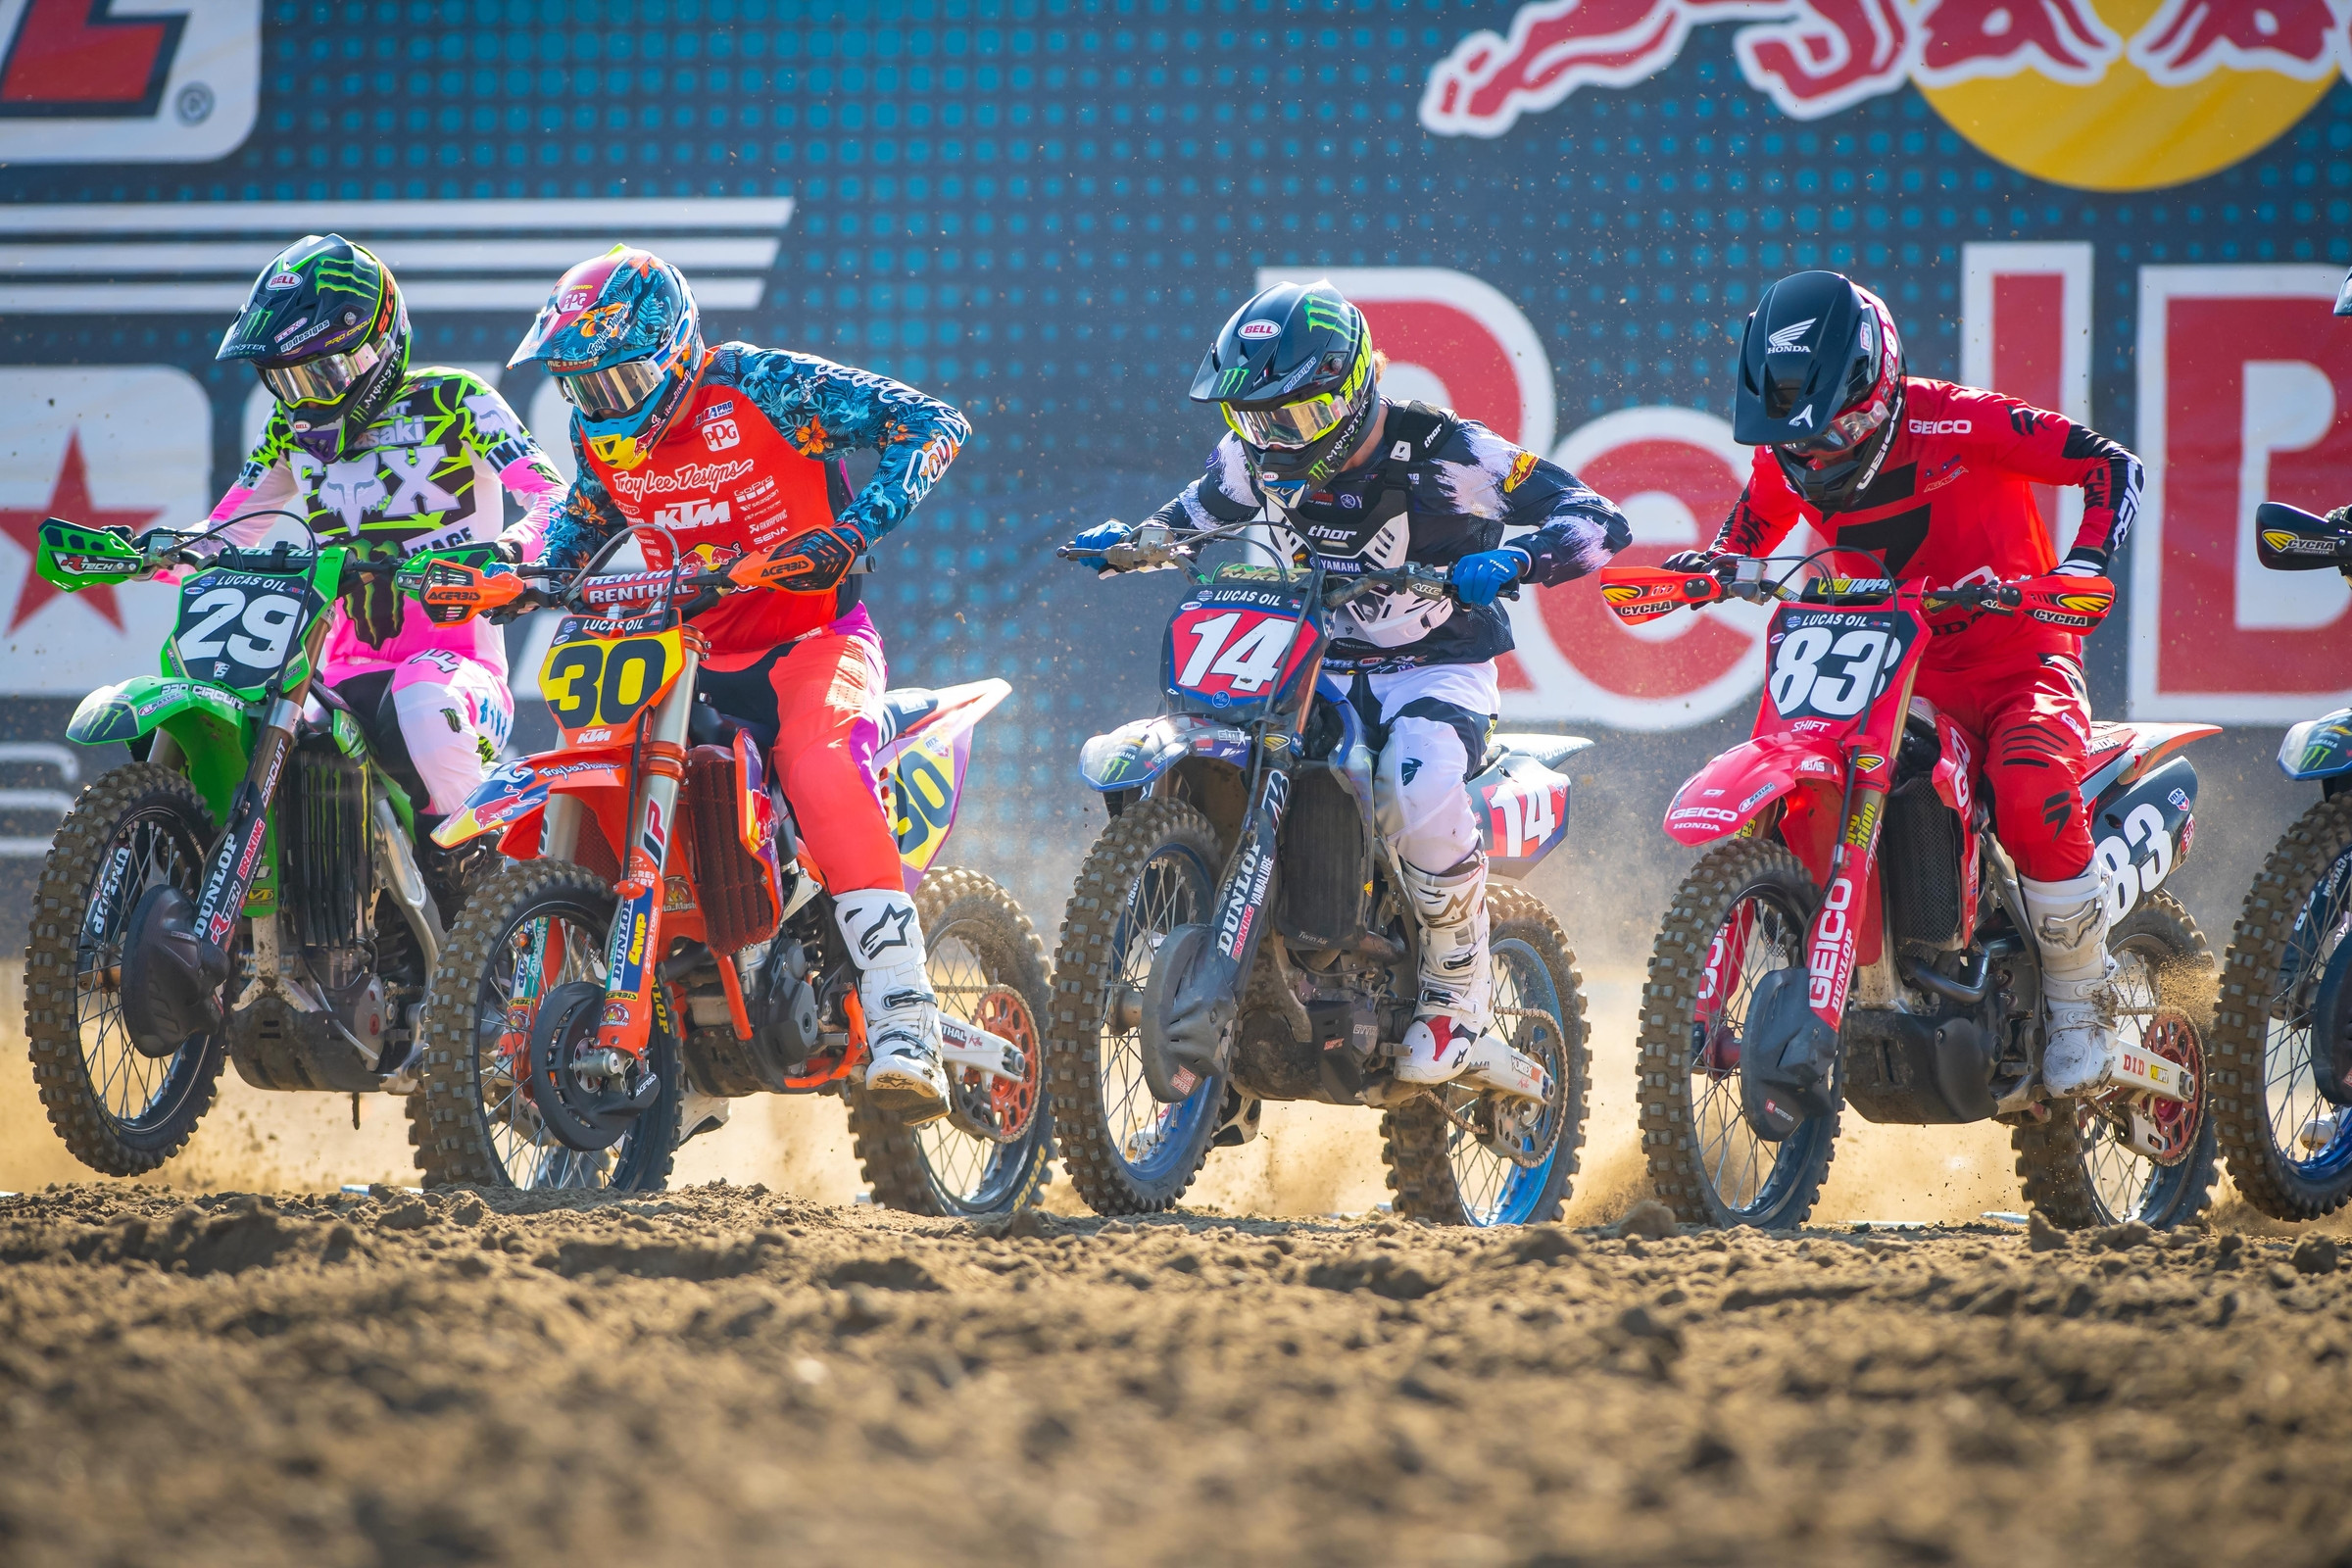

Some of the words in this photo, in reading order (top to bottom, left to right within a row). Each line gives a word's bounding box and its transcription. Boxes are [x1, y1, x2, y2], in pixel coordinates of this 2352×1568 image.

[270, 276, 295, 286] BELL
[280, 319, 329, 352] apdesigns
[1244, 324, 1273, 334] BELL
[324, 334, 346, 347] PRO
[1767, 344, 1812, 355] HONDA
[365, 343, 404, 404] MONSTER
[1283, 356, 1318, 393] apdesigns
[704, 424, 737, 448] PPG
[1326, 398, 1369, 462] MONSTER
[1424, 422, 1443, 449] thor
[1909, 418, 1972, 435] GEICO
[613, 470, 644, 502] Troy
[644, 470, 676, 493] Lee
[675, 459, 755, 494] Designs
[734, 475, 773, 497] GoPro
[752, 489, 779, 508] seaspan
[654, 498, 731, 530] KTM
[754, 526, 788, 545] SENA
[1308, 524, 1357, 541] thor
[2286, 539, 2335, 552] CYCRA
[760, 560, 809, 577] ACERBIS
[1320, 559, 1361, 572] YAMAHA
[217, 575, 261, 588] LUCAS
[263, 578, 286, 592] OIL
[587, 566, 695, 585] RENTHAL
[427, 591, 480, 601] ACERBIS
[589, 581, 695, 604] RENTHAL
[1214, 589, 1257, 603] LUCAS
[1259, 593, 1281, 607] OIL
[1412, 582, 1443, 596] ARC
[1620, 600, 1672, 615] CYCRA
[582, 619, 624, 631] LUCAS
[626, 619, 644, 630] OIL
[1801, 613, 1843, 626] LUCAS
[1845, 614, 1867, 627] OIL
[2034, 610, 2088, 626] CYCRA
[177, 588, 310, 669] 29
[1178, 612, 1298, 693] 14
[1769, 627, 1901, 715] 83
[548, 639, 666, 729] 30
[192, 685, 245, 711] CIRCUIT
[577, 729, 612, 744] KTM
[1790, 721, 1831, 733] SHIFT
[261, 738, 286, 808] CIRCUIT
[539, 764, 568, 780] Troy
[581, 761, 624, 775] Designs
[1489, 784, 1556, 858] 14
[1669, 807, 1739, 822] GEICO
[1673, 821, 1721, 831] HONDA
[237, 817, 266, 880] BRAKING
[2094, 804, 2173, 927] 83
[194, 833, 237, 939] DUNLOP
[1250, 855, 1275, 906] YAMALUBE
[1298, 930, 1315, 943] Twin
[1315, 935, 1329, 946] Air
[1809, 878, 1852, 1009] GEICO
[1831, 928, 1854, 1012] DUNLOP
[606, 991, 638, 1002] CERBIS
[2123, 1054, 2145, 1076] DID
